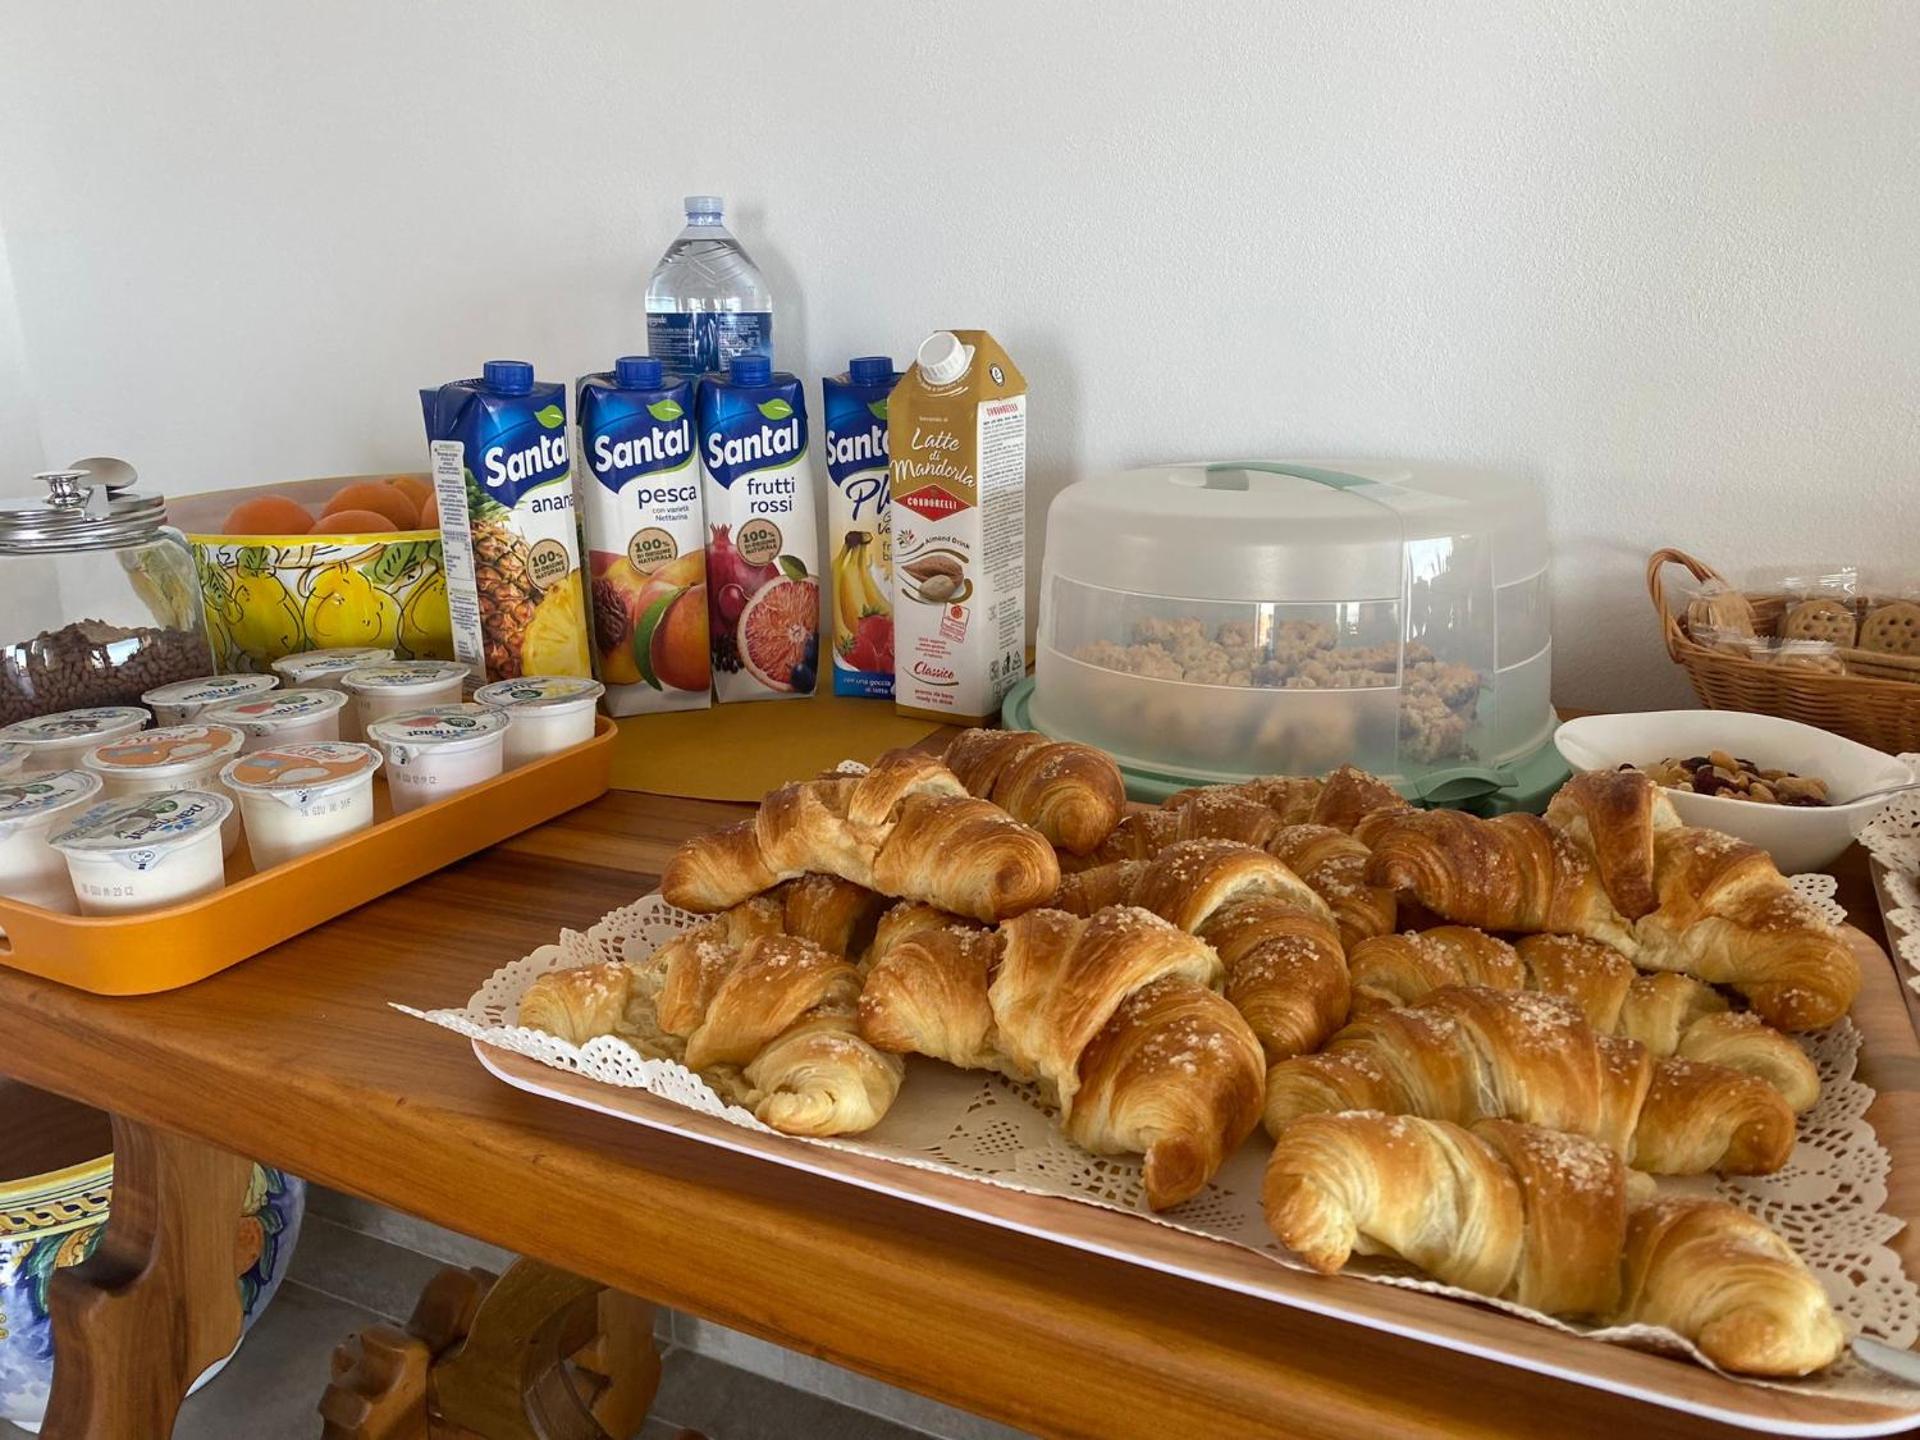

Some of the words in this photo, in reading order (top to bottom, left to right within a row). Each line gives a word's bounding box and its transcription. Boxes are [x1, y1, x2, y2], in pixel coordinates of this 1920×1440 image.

[594, 419, 690, 473] Santal
[708, 418, 799, 469] Santal
[911, 427, 961, 451] Latte
[928, 451, 940, 461] di
[890, 458, 976, 488] Mandorla
[747, 477, 795, 495] frutti
[638, 485, 697, 510] pesca
[750, 495, 793, 513] rossi
[907, 498, 957, 510] CONDORELLI
[635, 538, 670, 552] 100%
[743, 529, 775, 543] 100%
[925, 536, 951, 544] Almond
[951, 537, 970, 549] Drink
[532, 551, 563, 567] 100%
[914, 661, 954, 680] Classico
